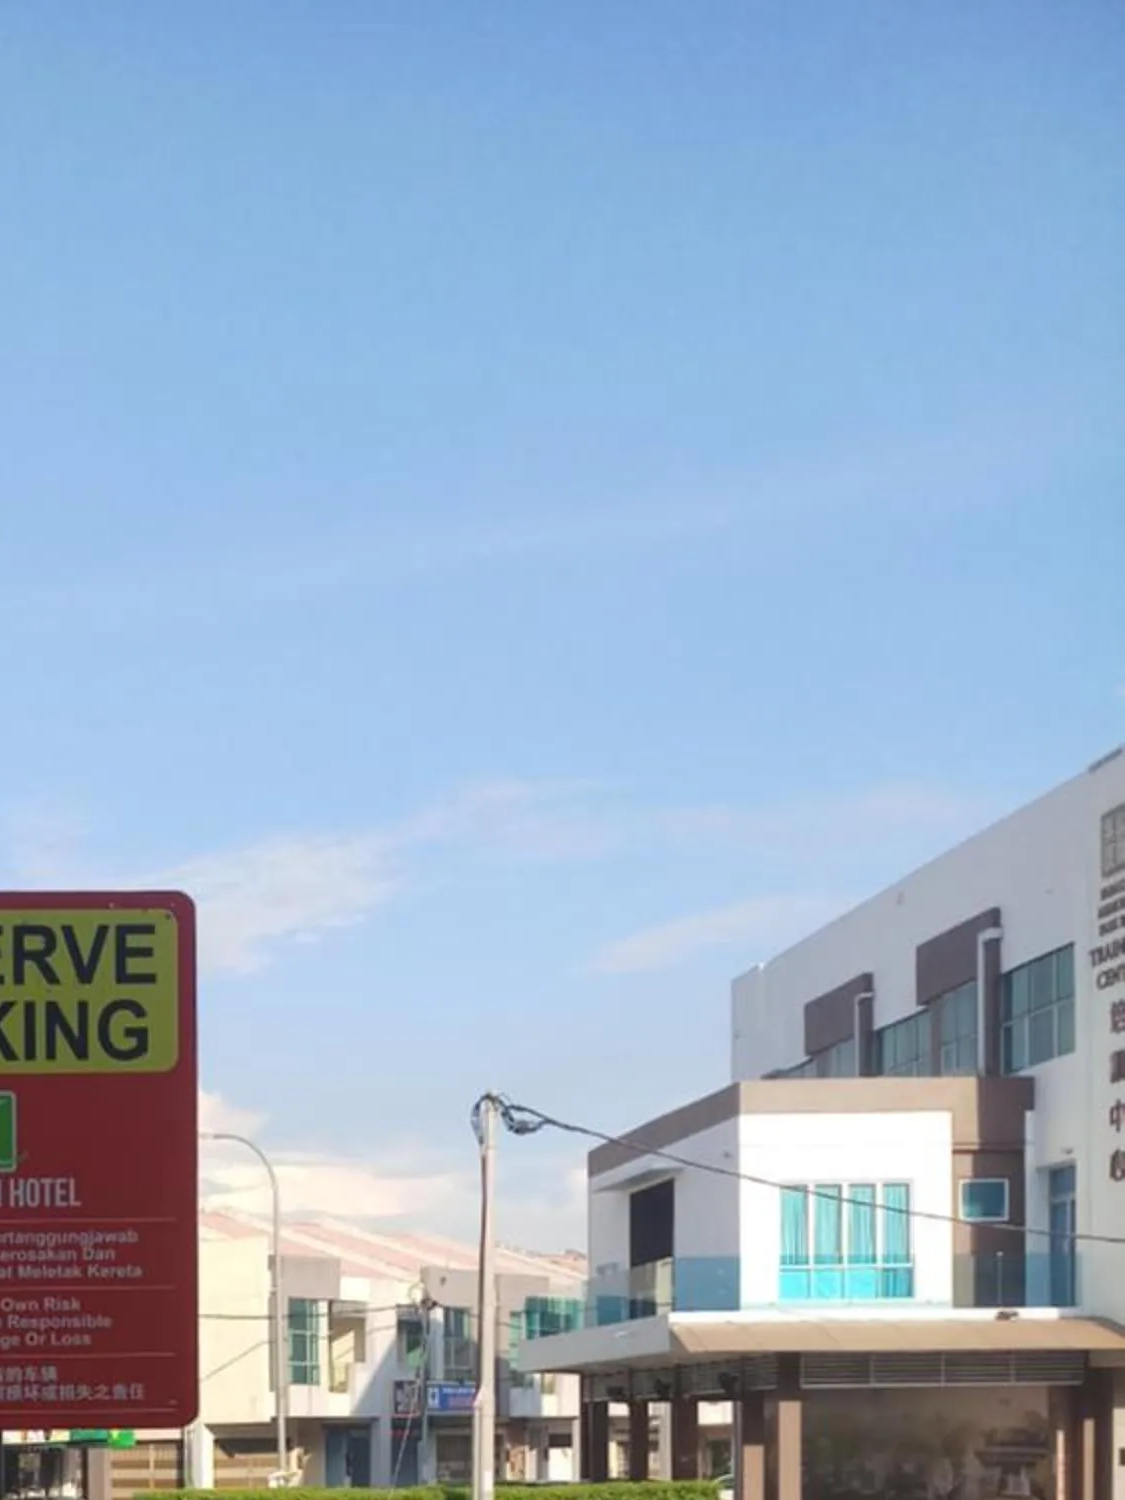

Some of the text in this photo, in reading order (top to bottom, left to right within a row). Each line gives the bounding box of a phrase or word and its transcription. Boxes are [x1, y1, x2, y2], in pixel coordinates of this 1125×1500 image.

[8, 1177, 81, 1208] HOTEL
[81, 1246, 116, 1261] Dan
[17, 1263, 83, 1279] Meletak
[87, 1262, 143, 1278] Kereta
[0, 1297, 39, 1312] Own
[44, 1296, 81, 1312] Risk
[6, 1313, 113, 1332] Responsible
[24, 1331, 46, 1346] Or
[50, 1330, 92, 1346] Loss
